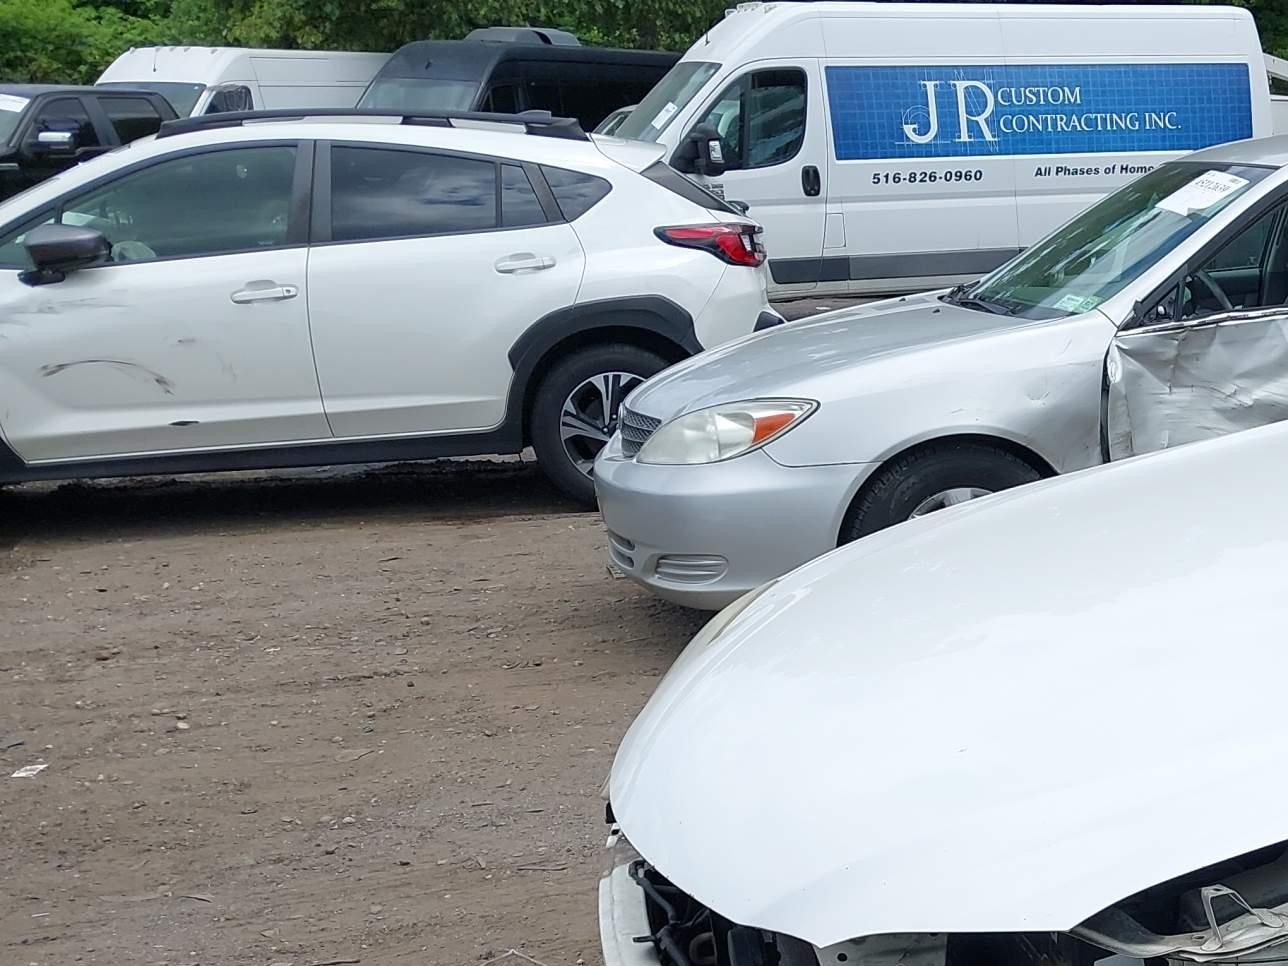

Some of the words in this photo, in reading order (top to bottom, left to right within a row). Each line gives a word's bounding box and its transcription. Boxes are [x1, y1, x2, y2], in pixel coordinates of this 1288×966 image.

[997, 86, 1081, 105] CUSTOM
[999, 112, 1139, 133] CONTRACTING
[1144, 111, 1183, 130] INC.
[872, 169, 983, 185] 516-826-0960
[1034, 166, 1051, 177] All
[1055, 164, 1100, 176] Phases
[1103, 164, 1117, 175] of
